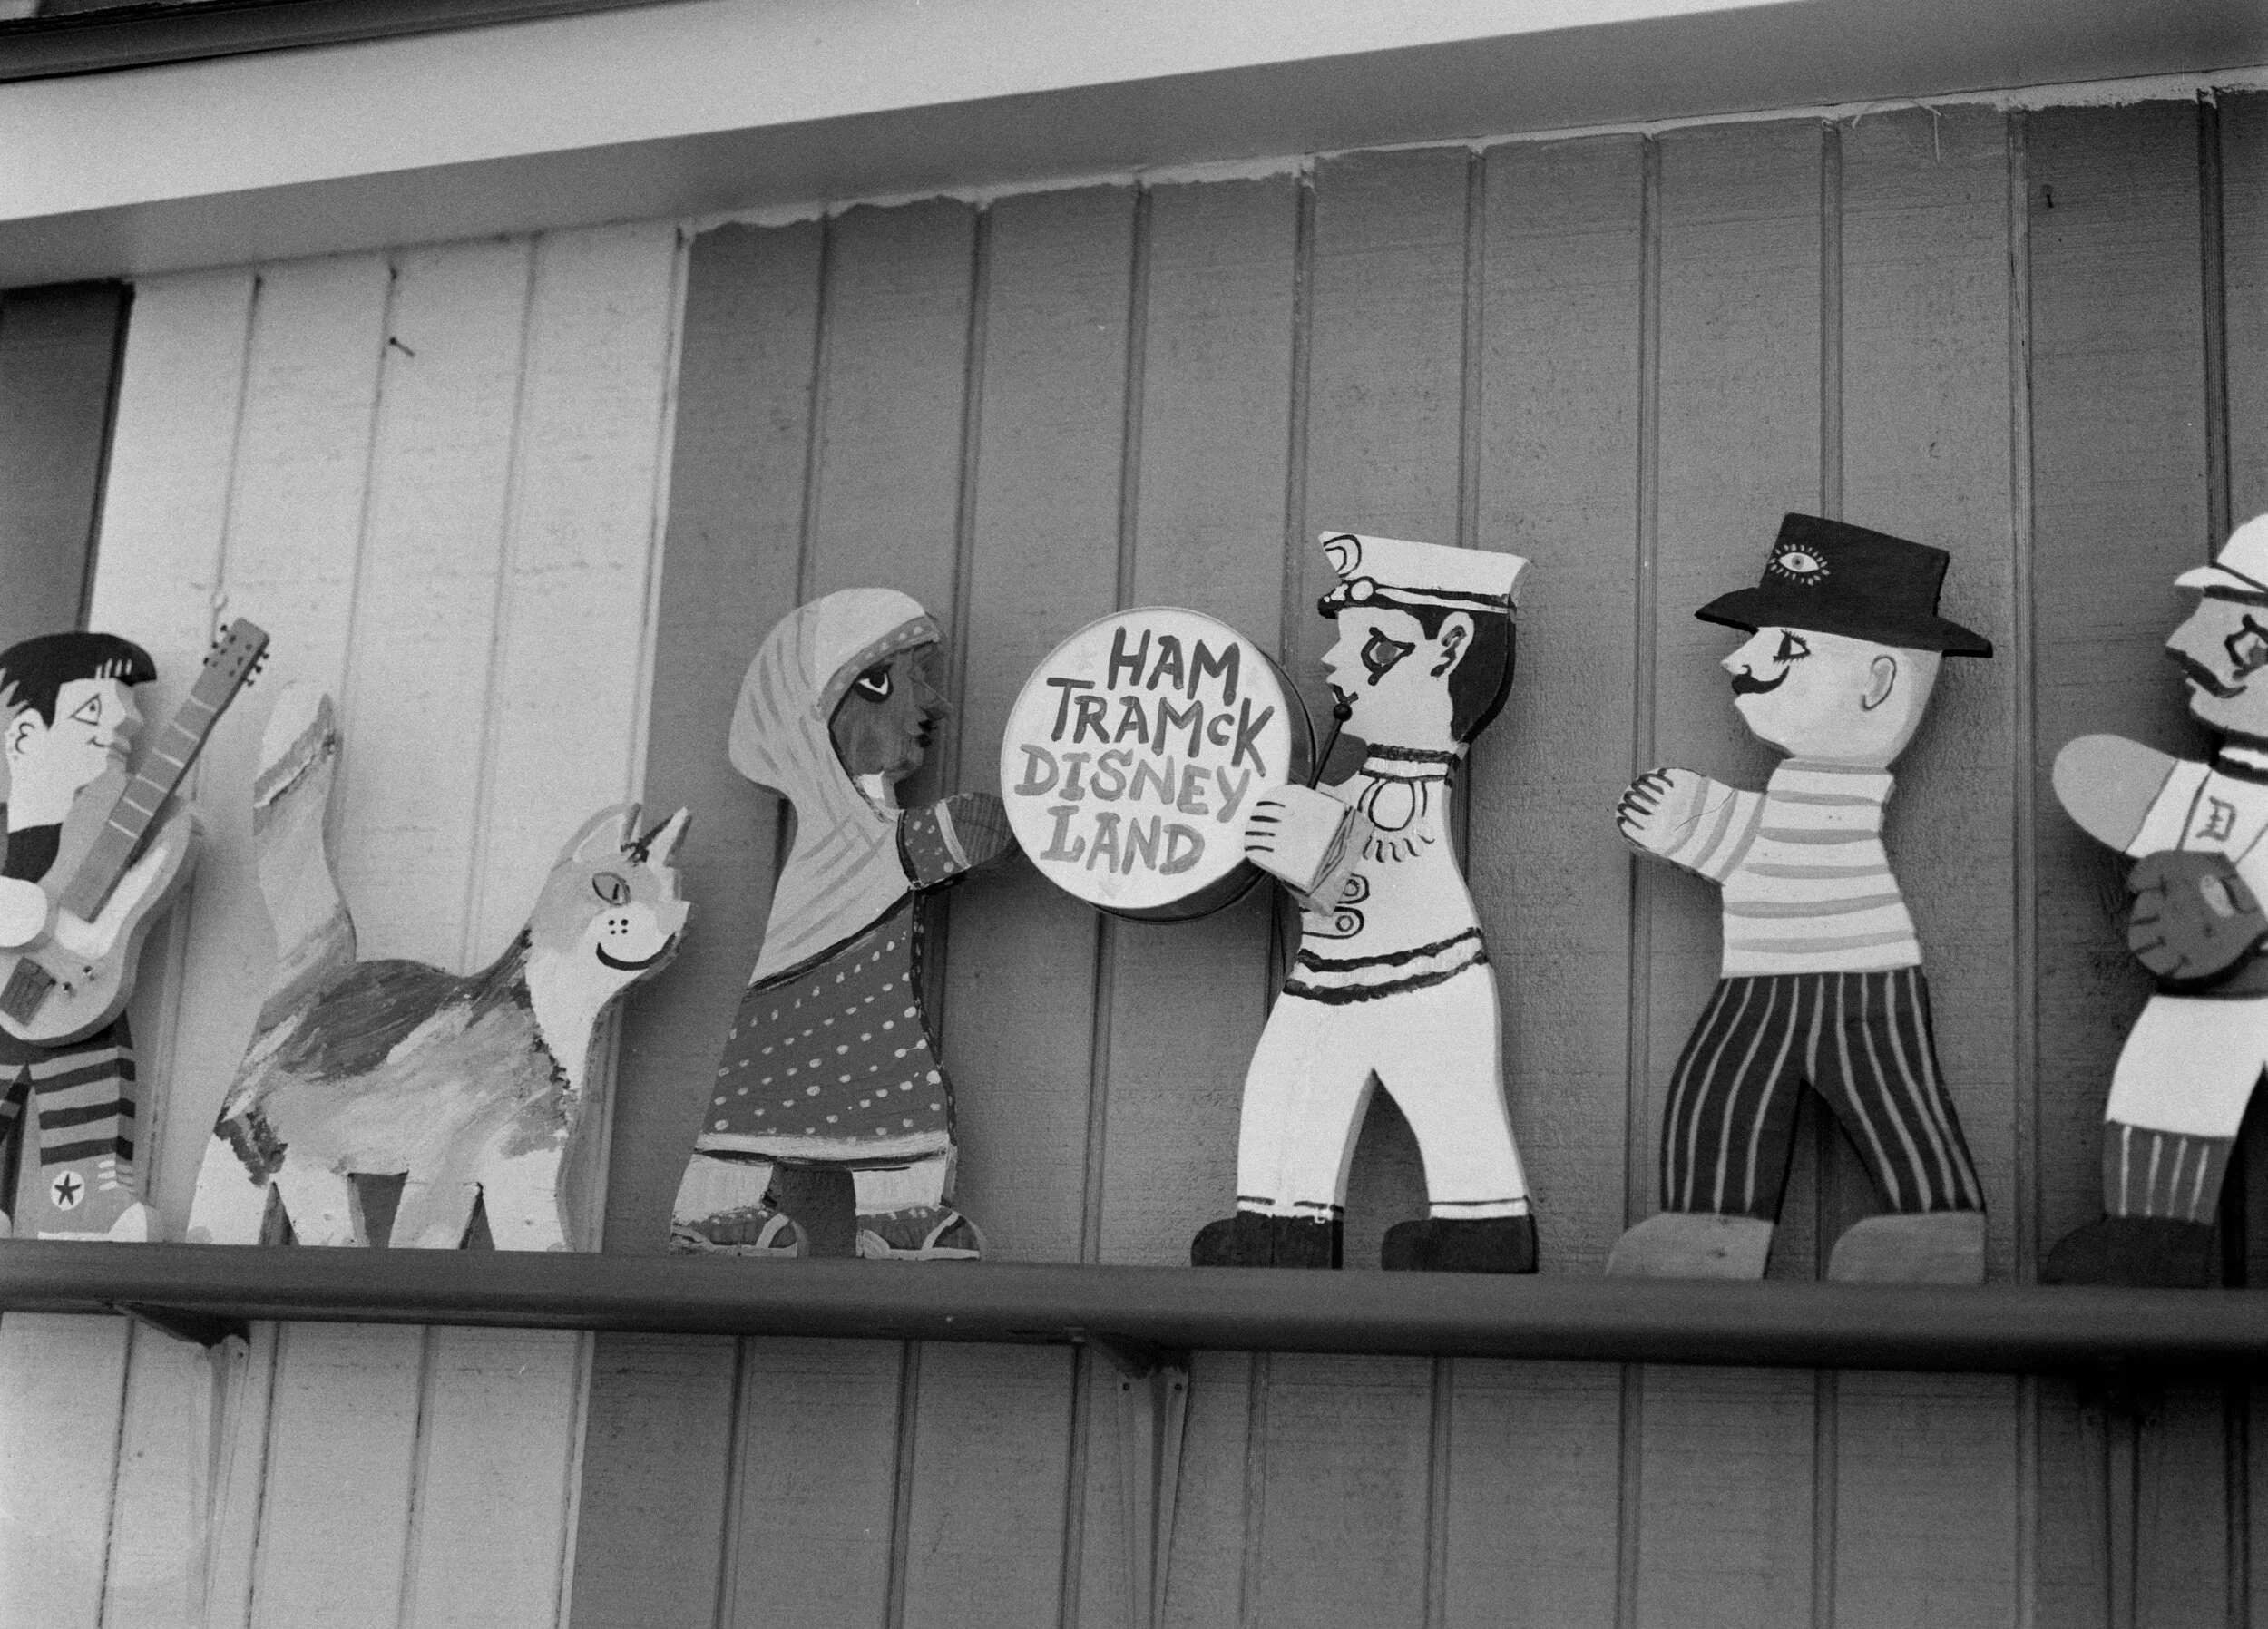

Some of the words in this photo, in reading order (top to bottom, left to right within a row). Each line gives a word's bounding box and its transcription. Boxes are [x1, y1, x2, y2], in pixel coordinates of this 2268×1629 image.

[1107, 626, 1241, 707] HAM
[1013, 743, 1251, 824] DISNEY
[1039, 805, 1206, 876] LAND
